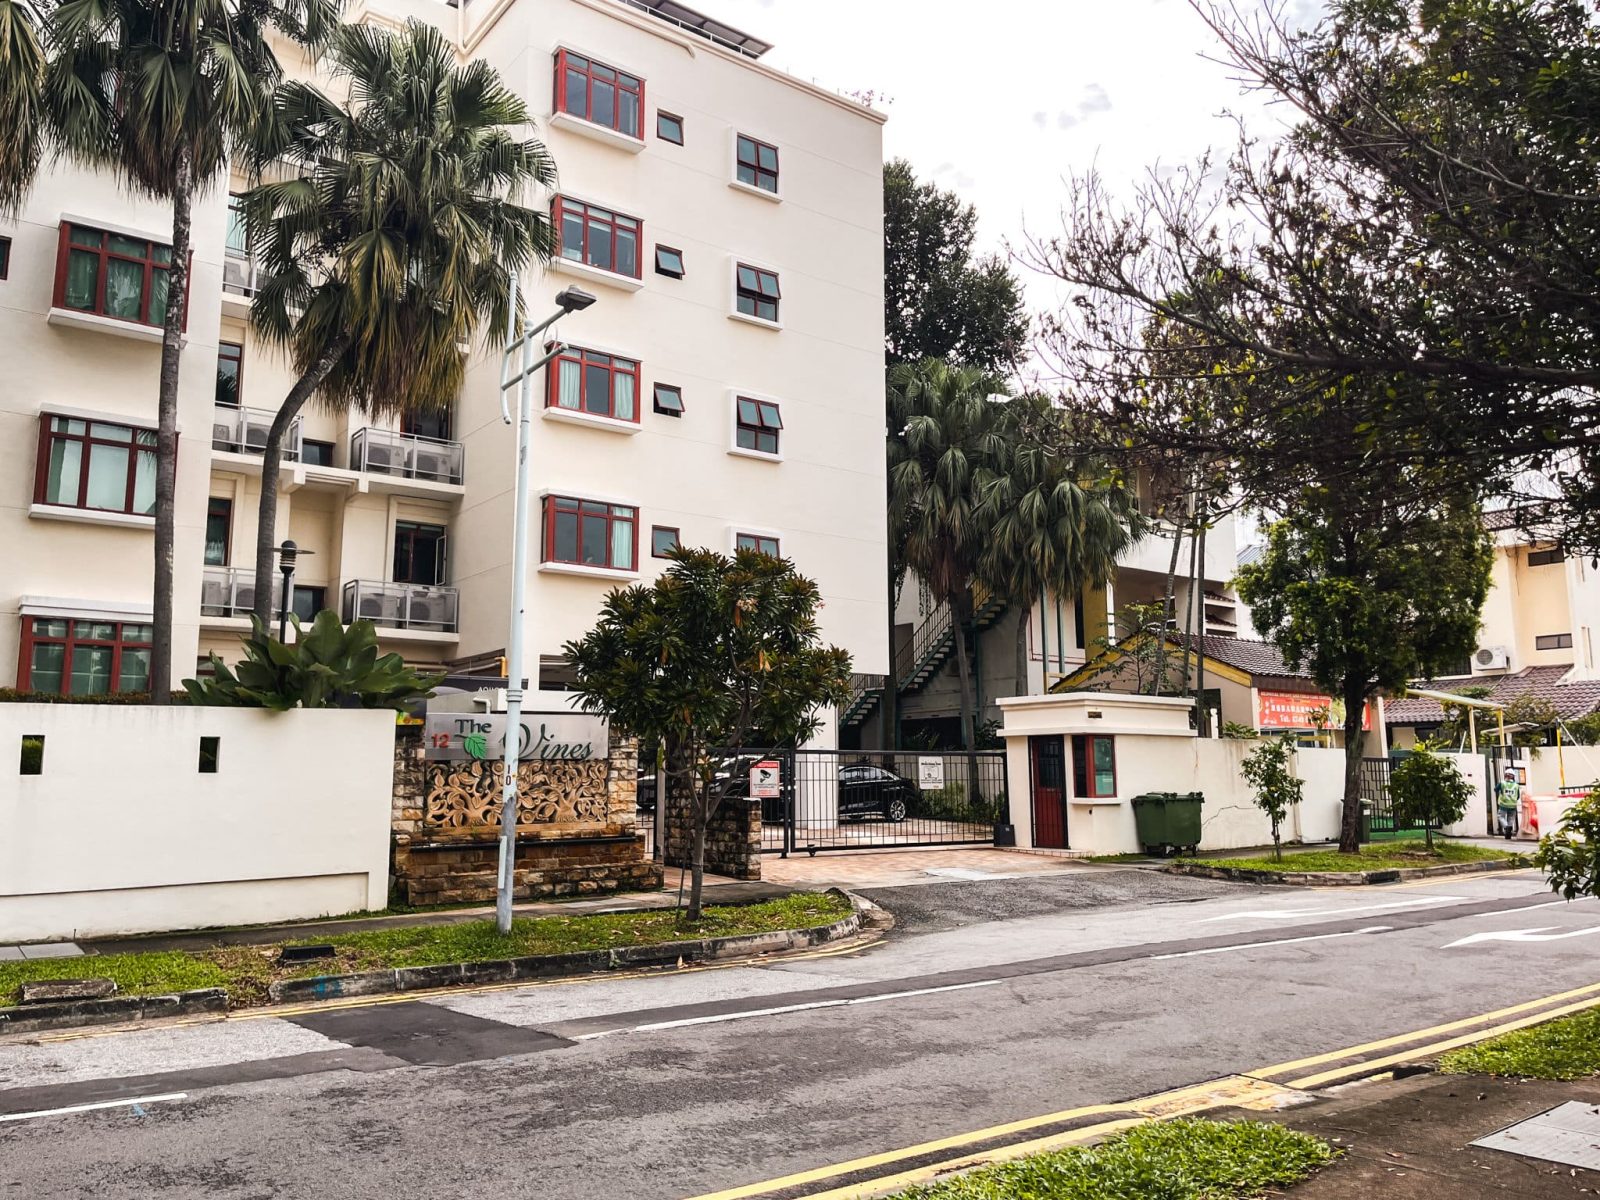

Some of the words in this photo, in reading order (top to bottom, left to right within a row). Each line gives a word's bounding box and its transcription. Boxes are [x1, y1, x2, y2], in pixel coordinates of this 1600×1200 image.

[431, 733, 450, 748] 12
[455, 719, 492, 733] The
[499, 723, 593, 759] Vines
